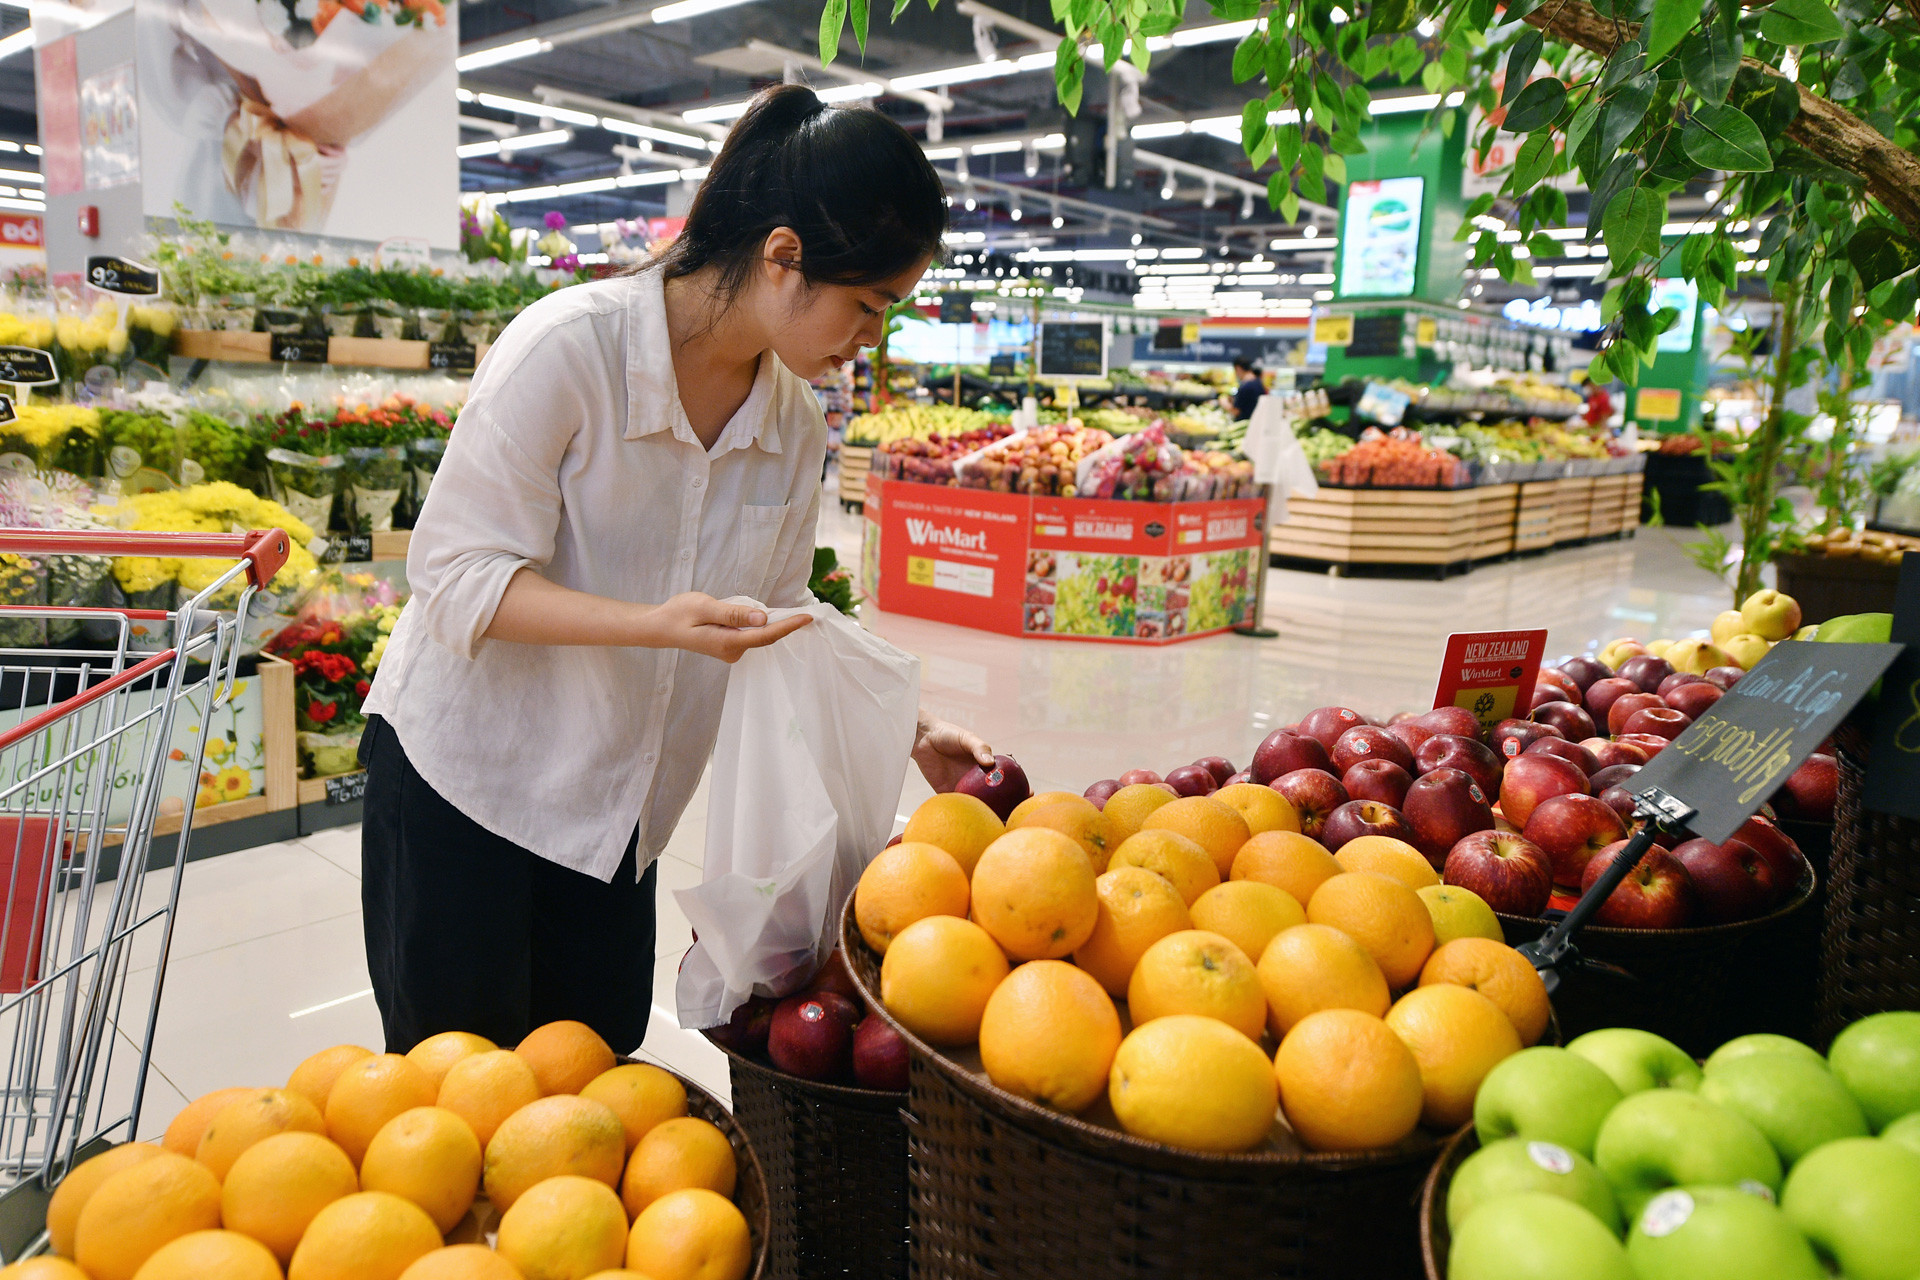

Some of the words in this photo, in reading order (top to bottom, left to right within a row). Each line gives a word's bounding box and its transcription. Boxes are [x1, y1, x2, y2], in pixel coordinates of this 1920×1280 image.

[905, 517, 987, 550] WinMart
[1465, 643, 1488, 658] NEW
[1488, 640, 1529, 656] ZEALAND
[1461, 668, 1502, 681] WinMart
